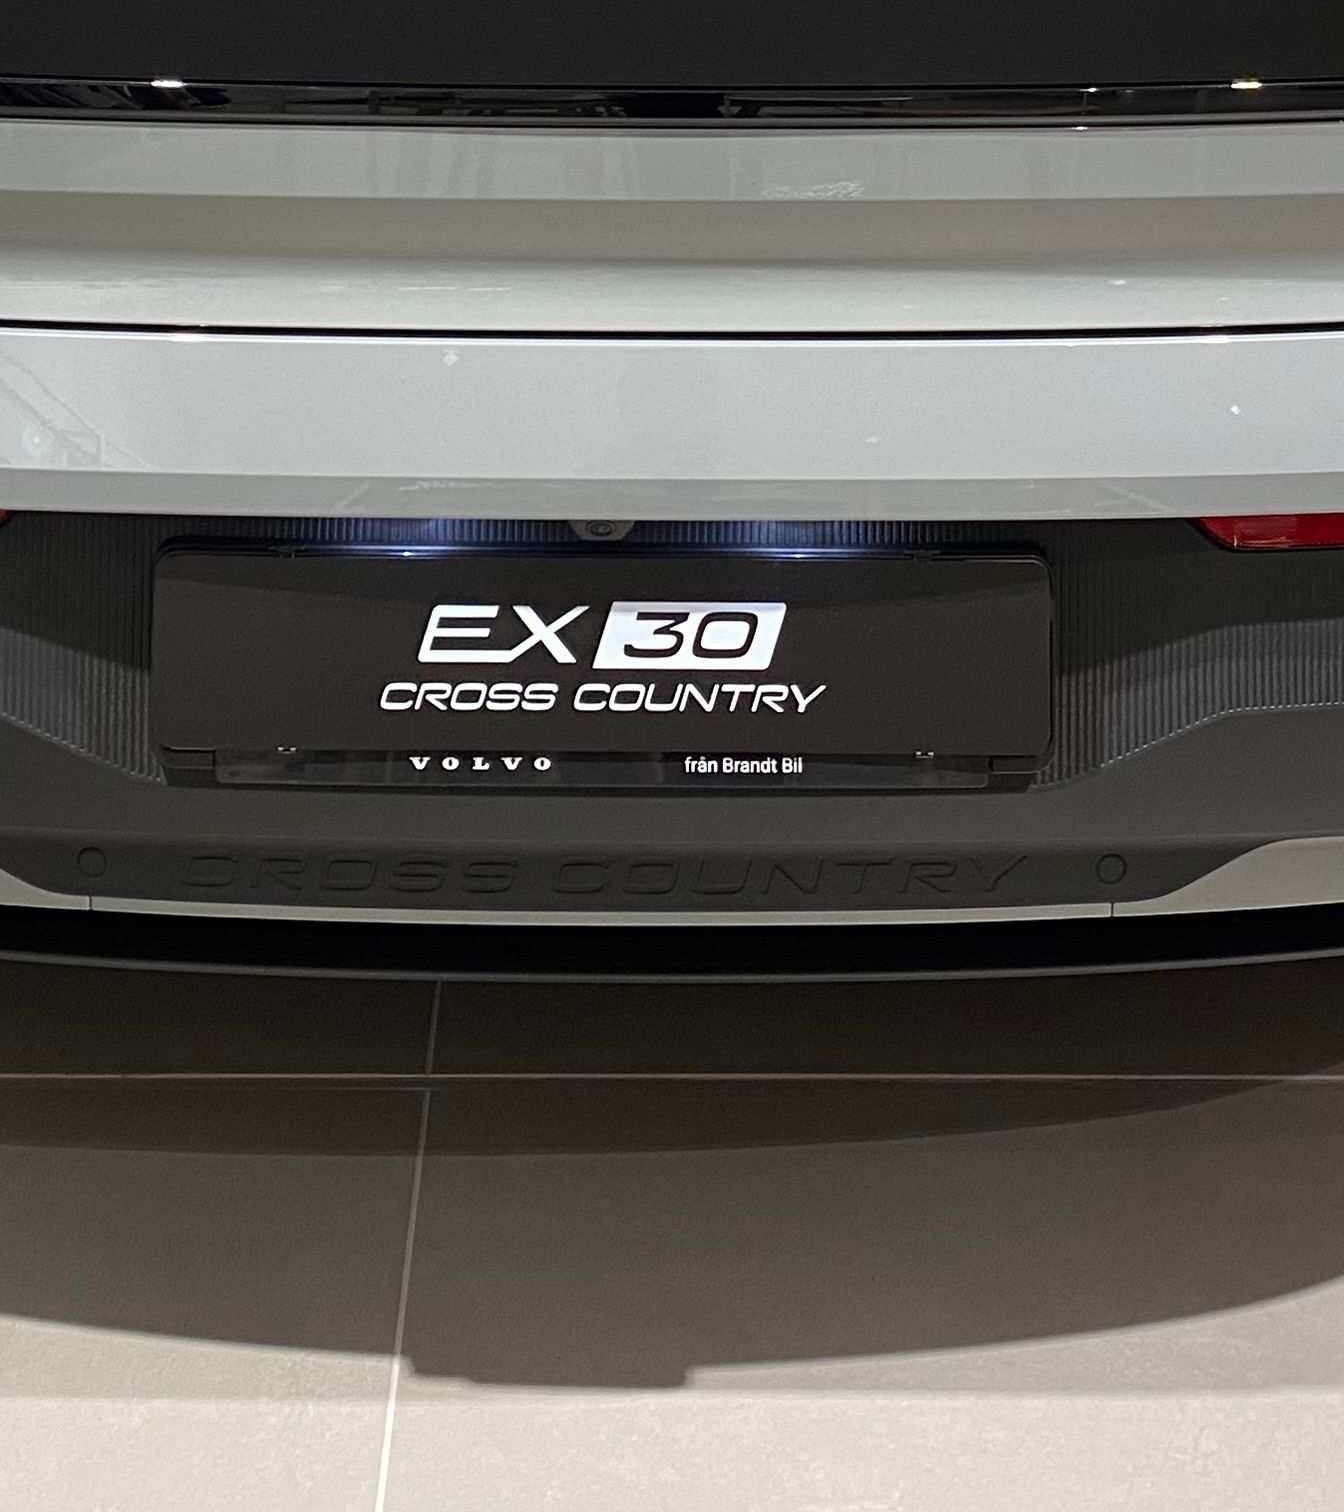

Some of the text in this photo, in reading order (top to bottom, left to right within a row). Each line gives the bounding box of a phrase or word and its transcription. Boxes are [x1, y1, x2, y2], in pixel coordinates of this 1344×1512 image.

[418, 604, 759, 663] EX 30
[380, 682, 827, 713] CROSS COUNTRY
[409, 755, 553, 772] VOLVO
[683, 754, 803, 775] från Brandt Bil
[178, 854, 1030, 895] CROSS COUNTRY
